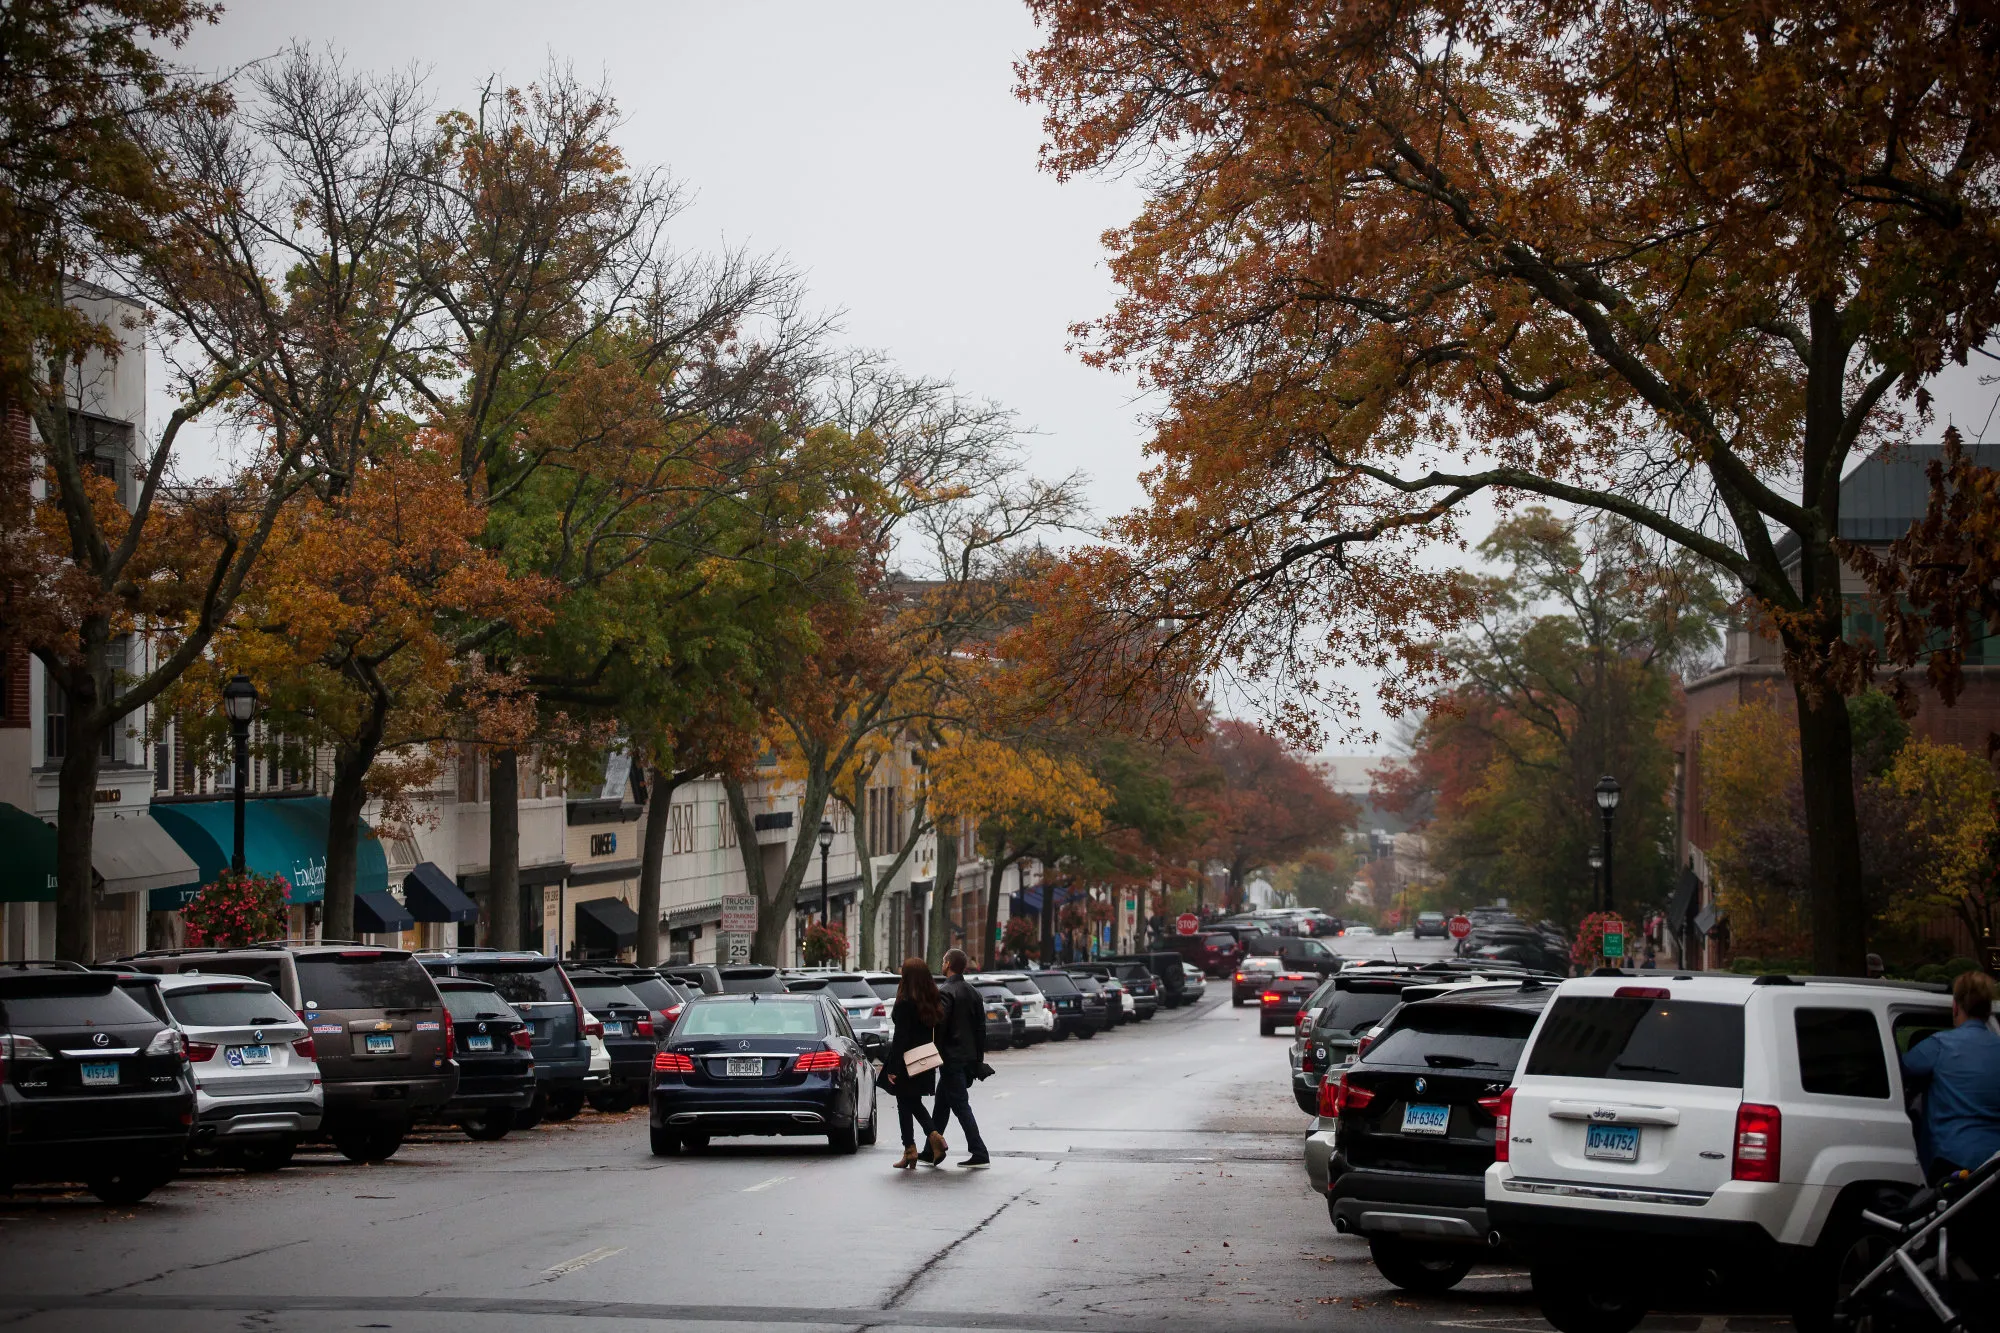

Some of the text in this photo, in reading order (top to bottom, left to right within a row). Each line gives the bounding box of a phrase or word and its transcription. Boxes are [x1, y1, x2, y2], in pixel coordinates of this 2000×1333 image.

[725, 897, 755, 905] TRUCKS
[1178, 919, 1197, 929] STOP
[1450, 922, 1470, 932] STOP
[731, 945, 748, 956] 25
